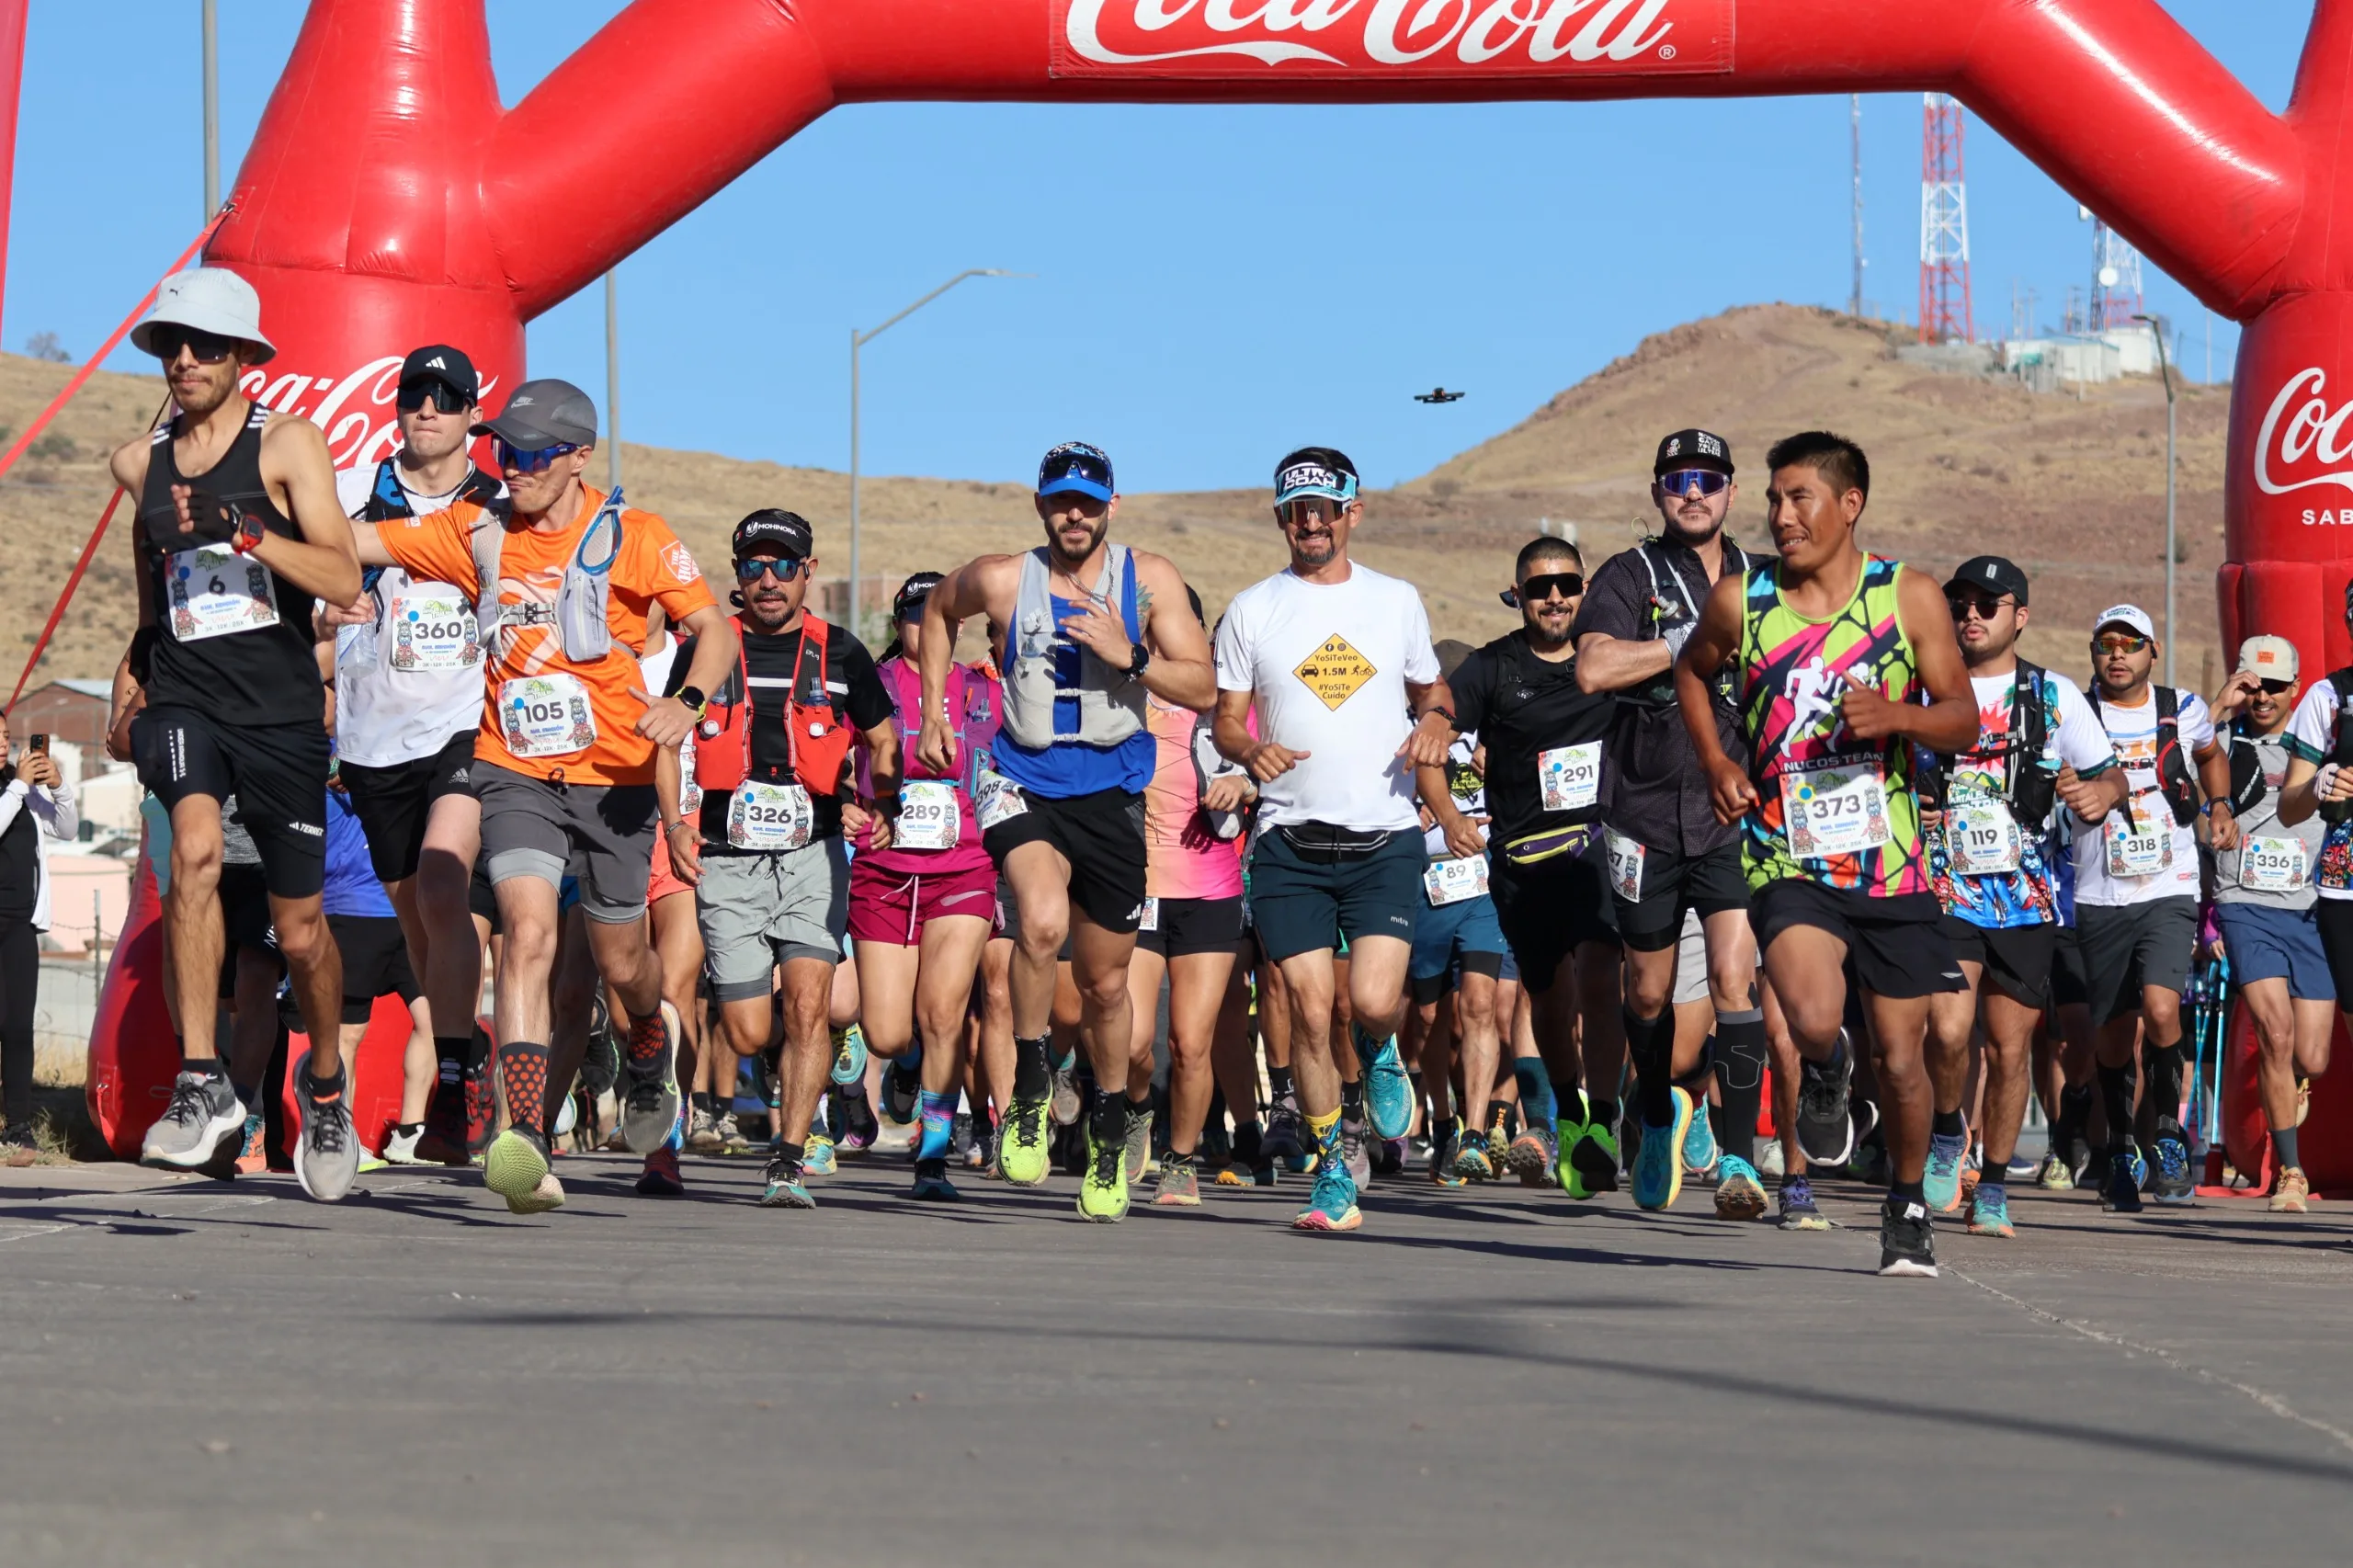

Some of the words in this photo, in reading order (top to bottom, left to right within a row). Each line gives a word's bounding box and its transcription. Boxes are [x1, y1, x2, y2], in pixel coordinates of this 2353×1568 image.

[1284, 477, 1336, 490] COAH
[209, 574, 226, 595] 6
[415, 622, 462, 640] 360
[1322, 667, 1347, 676] 1.5M
[1322, 691, 1346, 699] Cuido
[524, 701, 564, 723] 105
[1783, 756, 1839, 772] NUCOS
[1563, 765, 1593, 783] 291
[977, 780, 1002, 806] 398
[903, 804, 940, 820] 289
[1813, 794, 1860, 819] 373
[749, 806, 791, 824] 326
[1970, 829, 1997, 846] 119
[2128, 838, 2156, 853] 318
[2256, 855, 2290, 868] 336
[1446, 864, 1466, 879] 89
[1390, 915, 1408, 926] mitre
